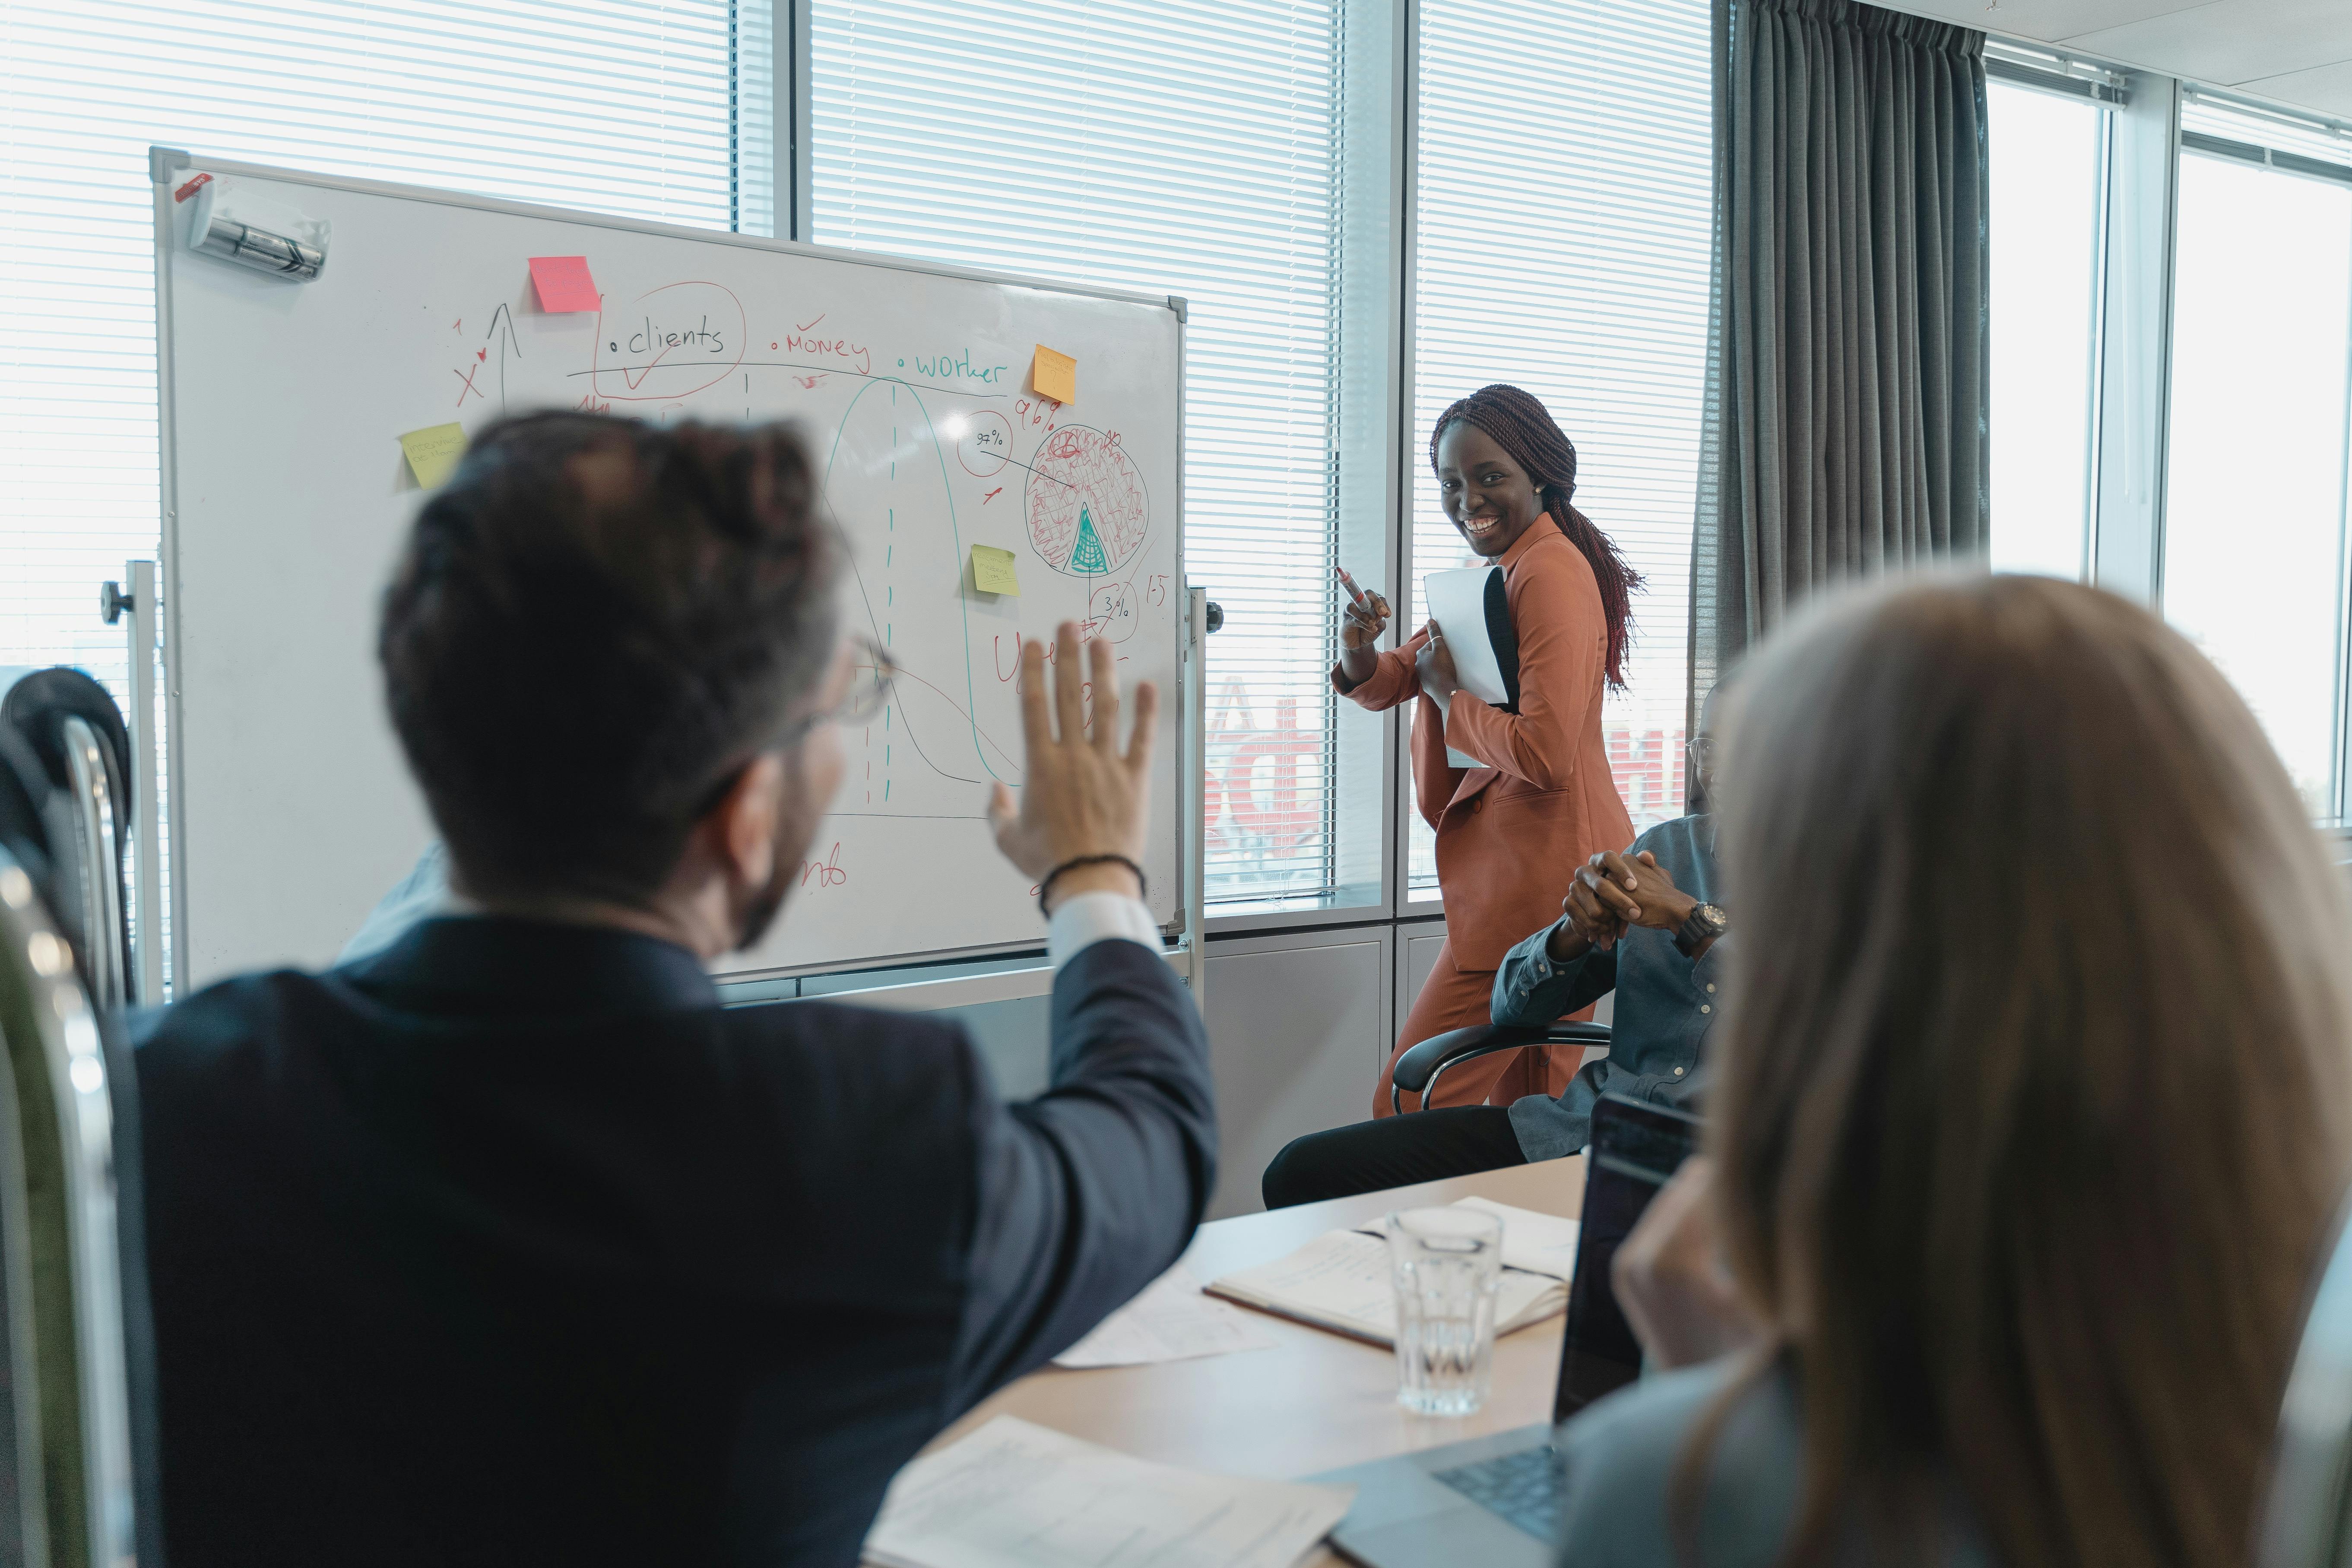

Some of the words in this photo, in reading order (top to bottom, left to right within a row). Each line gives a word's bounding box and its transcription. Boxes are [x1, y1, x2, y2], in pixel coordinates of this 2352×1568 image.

[630, 315, 724, 354] clients
[1015, 399, 1062, 434] 96%
[977, 429, 1003, 446] 97%
[412, 454, 428, 462] at
[1105, 597, 1128, 617] 3%
